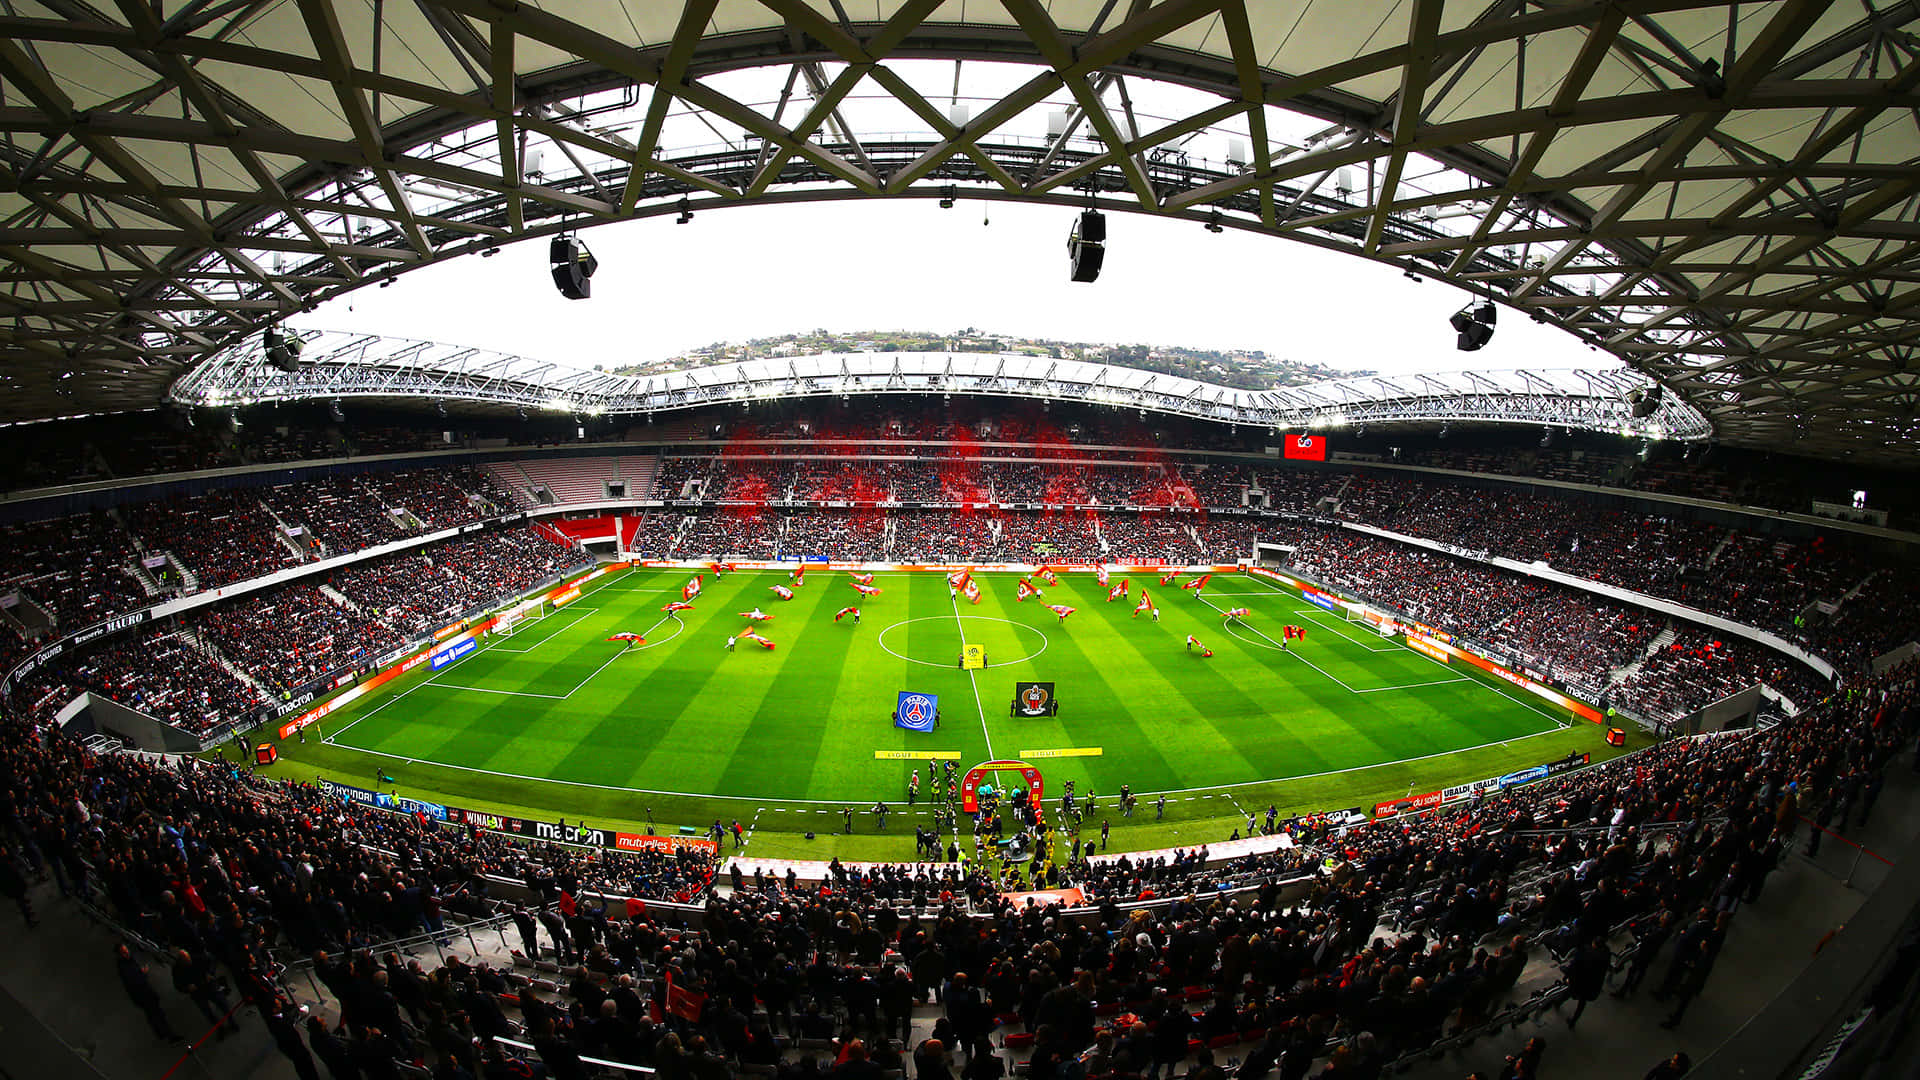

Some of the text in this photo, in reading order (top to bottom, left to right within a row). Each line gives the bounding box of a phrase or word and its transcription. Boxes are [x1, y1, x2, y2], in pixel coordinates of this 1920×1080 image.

[106, 613, 143, 632] MAURO
[278, 692, 314, 716] macron
[906, 697, 928, 706] PARIS
[1566, 685, 1599, 706] macron
[336, 786, 373, 803] HYUNDAI
[1444, 779, 1498, 797] UBALDI UBALDI
[423, 803, 443, 817] NICE
[466, 811, 503, 830] WINAAX
[619, 837, 668, 851] mutuelles
